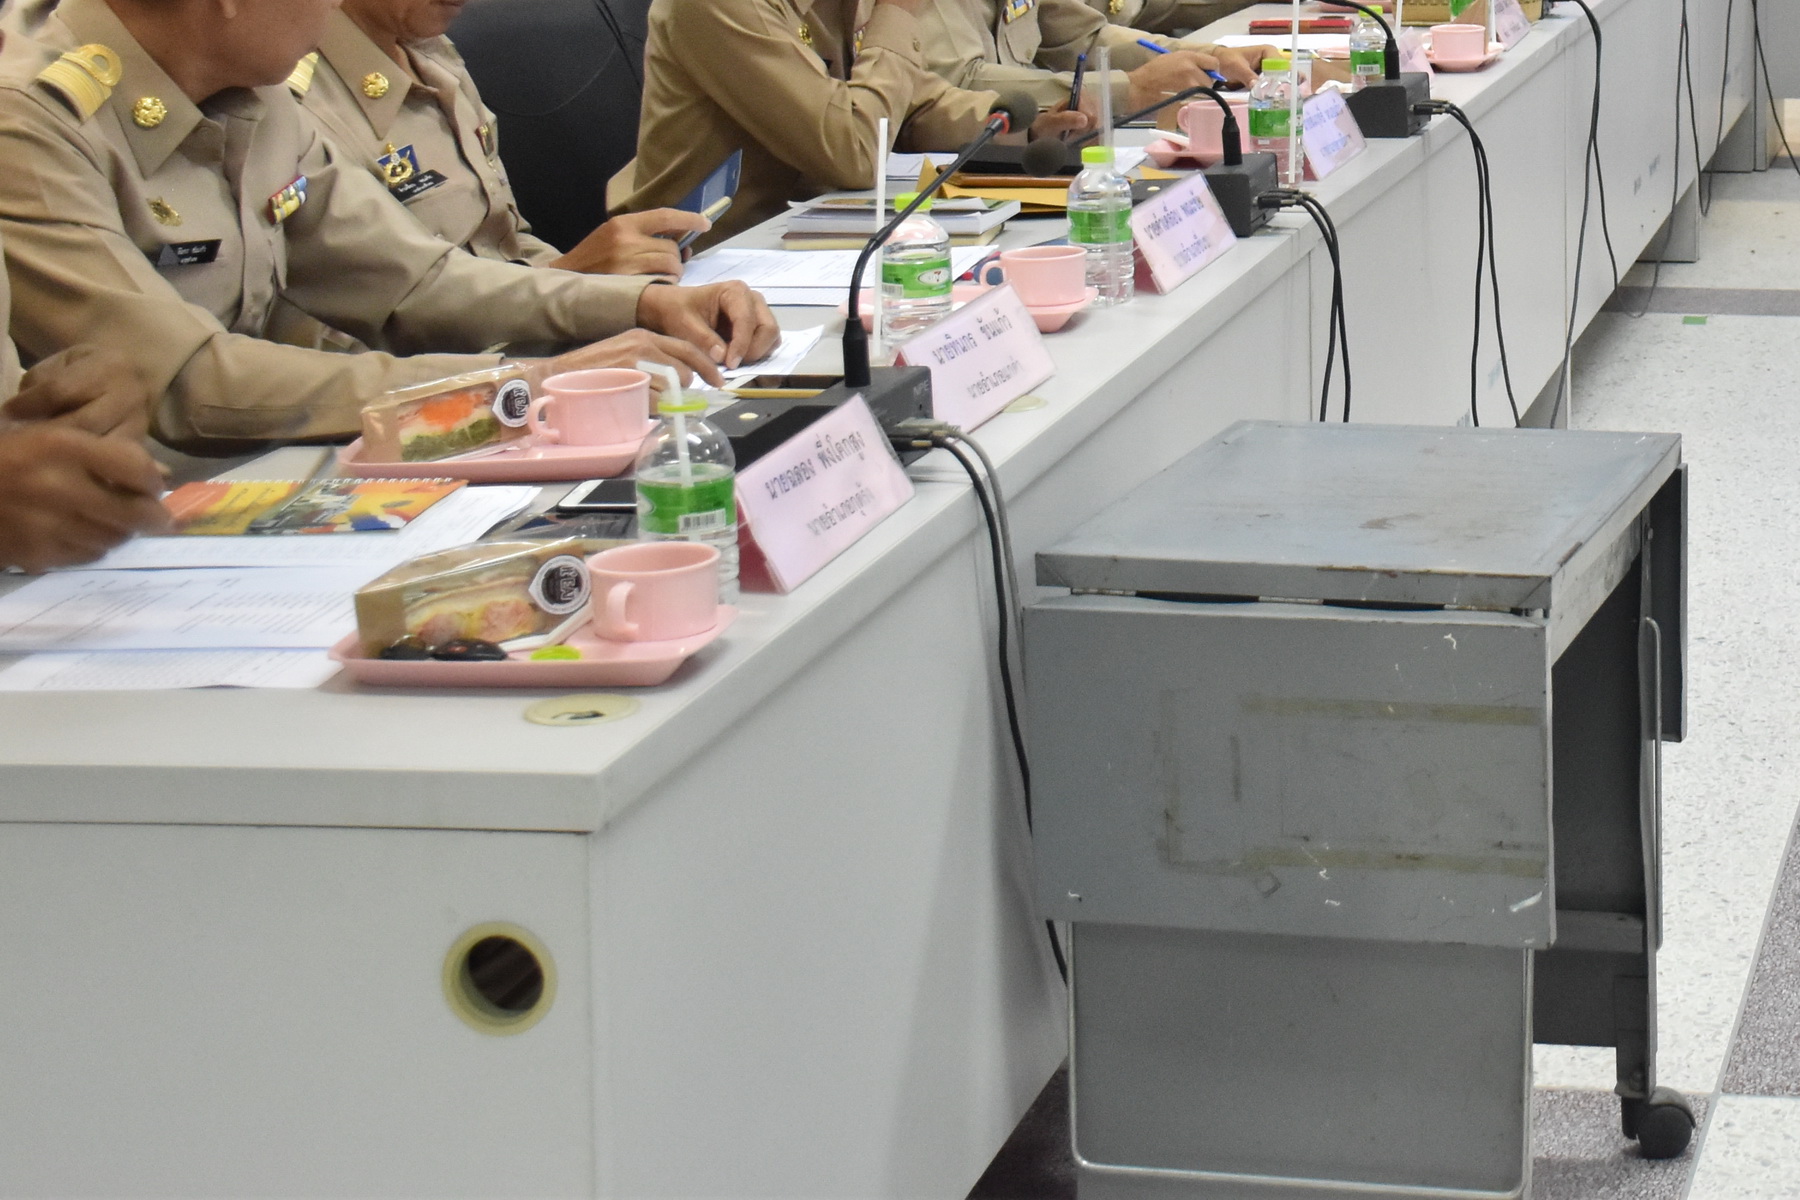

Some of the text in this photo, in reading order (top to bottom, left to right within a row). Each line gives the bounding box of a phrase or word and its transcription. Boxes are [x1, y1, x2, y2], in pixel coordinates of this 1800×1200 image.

[932, 333, 978, 365] นายทินกร
[765, 459, 816, 500] นายฉลอง
